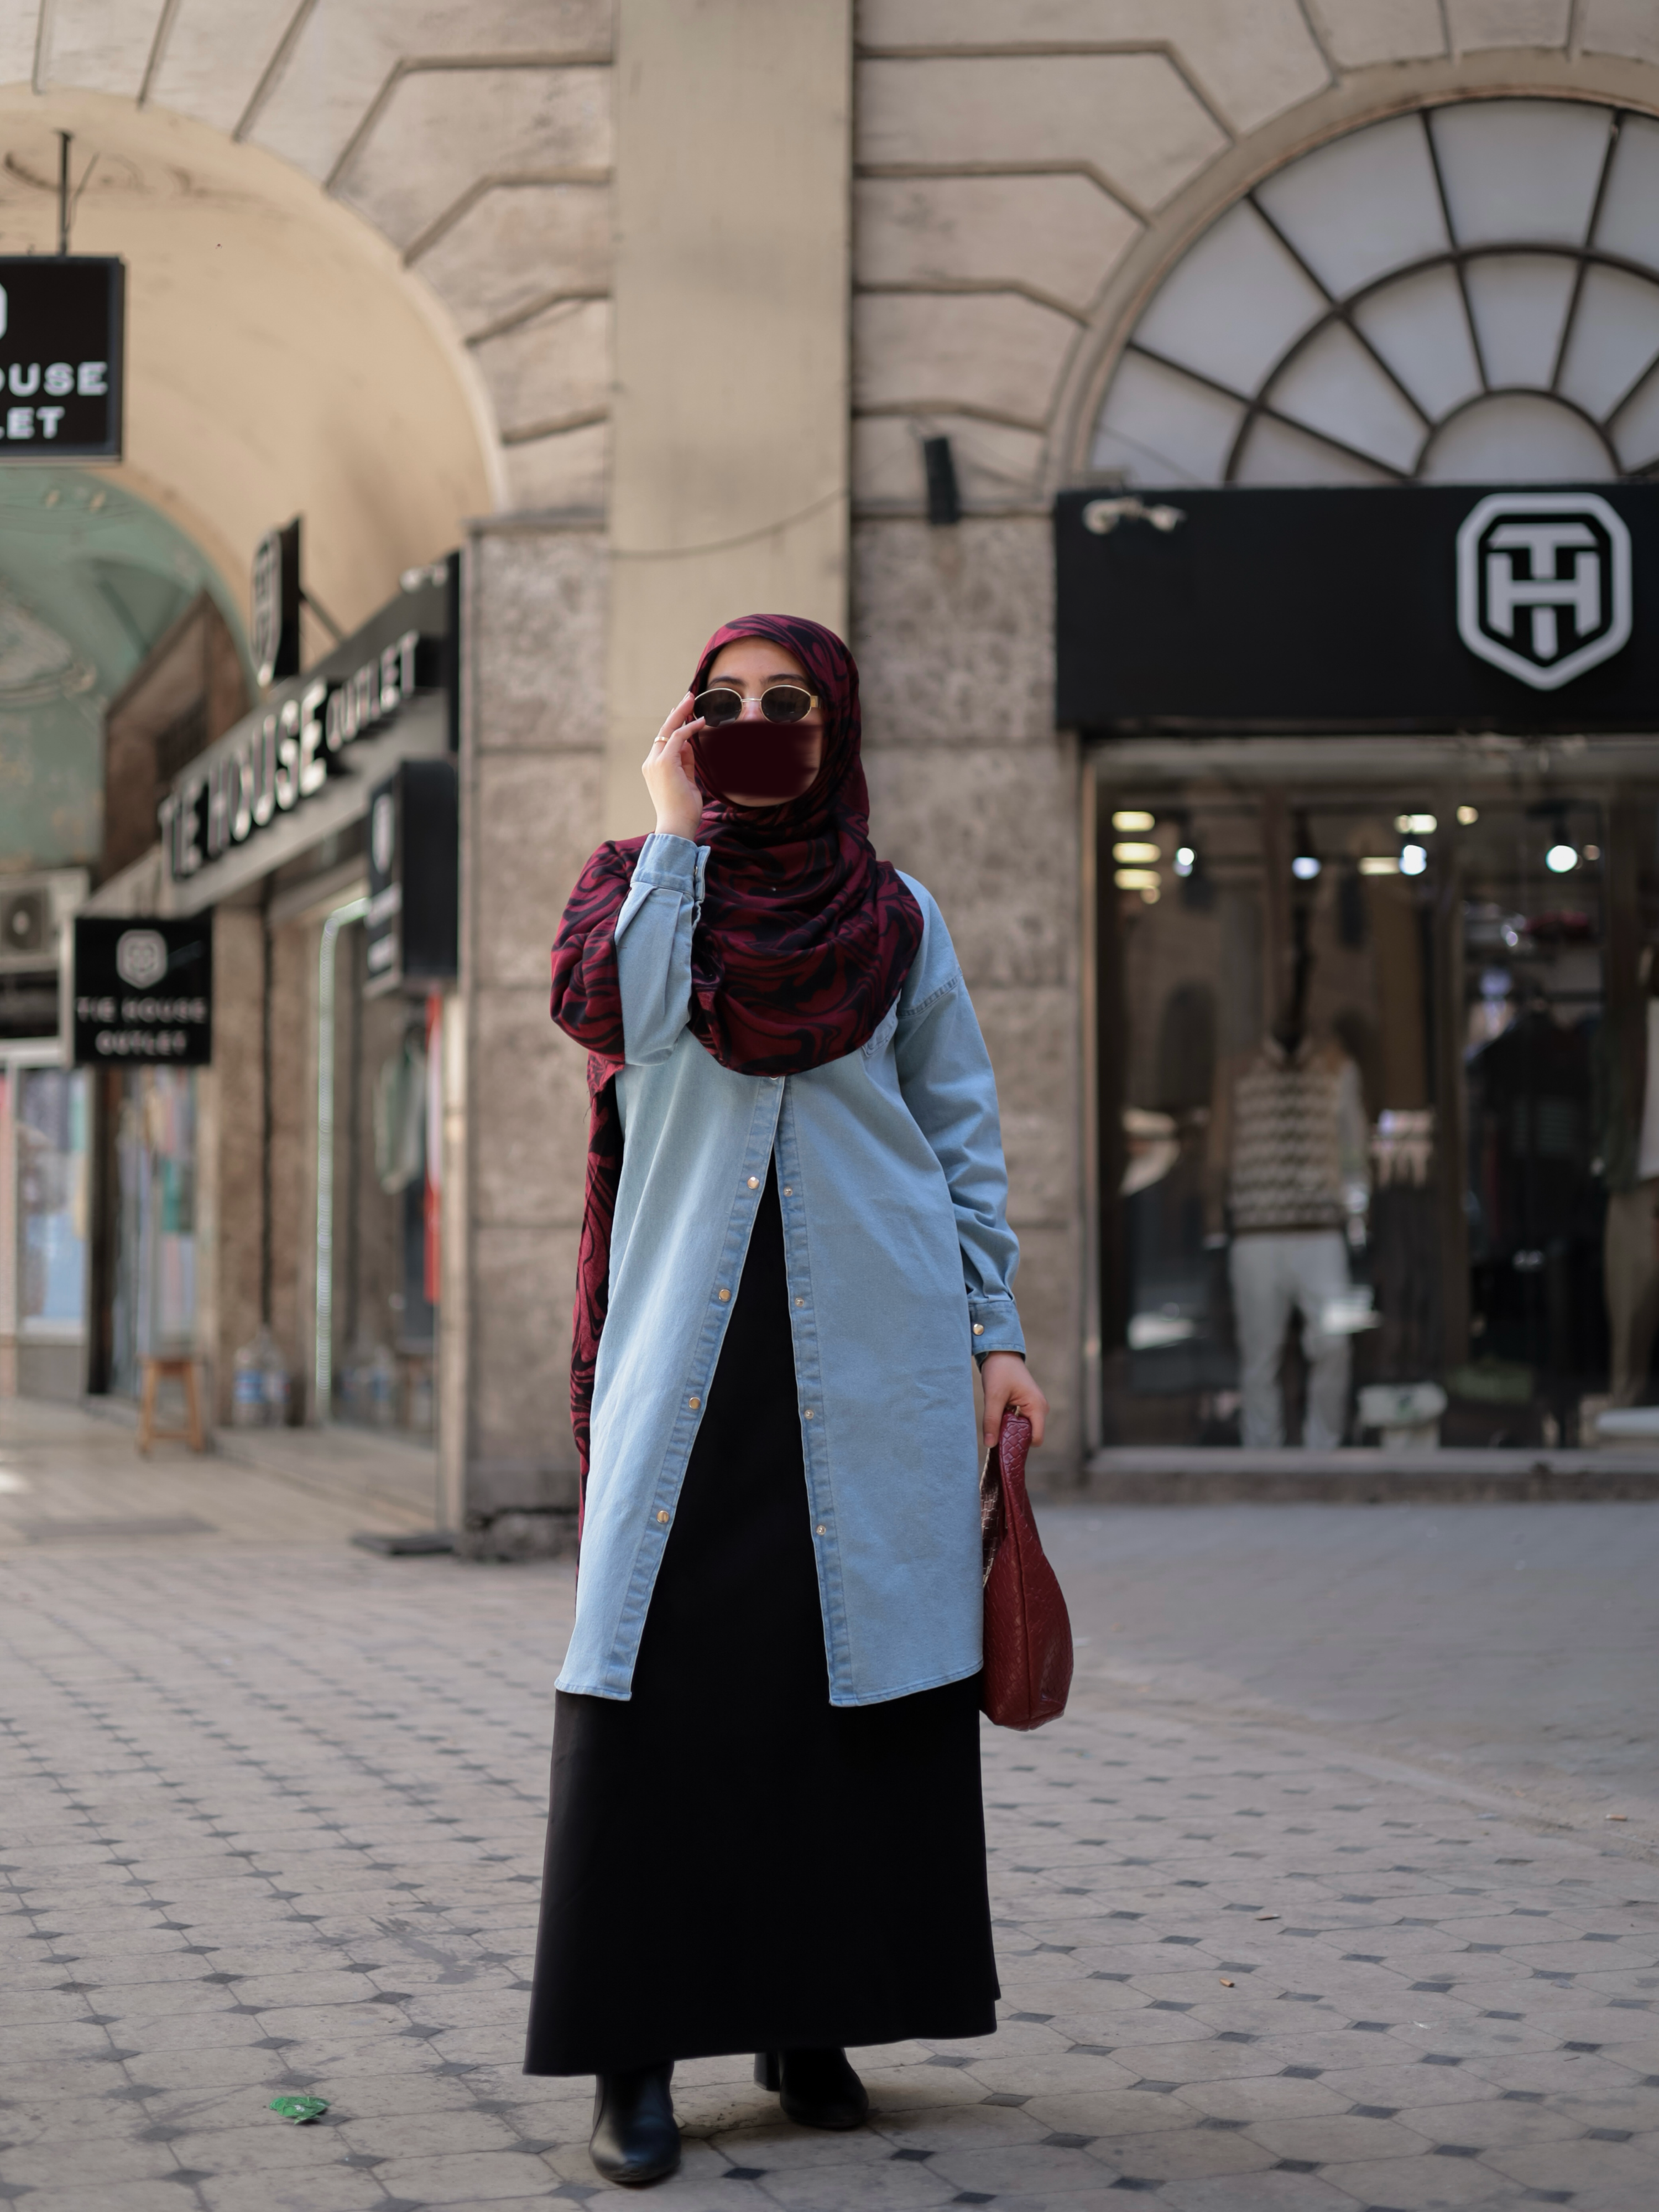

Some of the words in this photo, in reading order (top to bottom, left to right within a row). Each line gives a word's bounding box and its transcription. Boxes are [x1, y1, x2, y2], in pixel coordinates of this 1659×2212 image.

[0, 362, 108, 397] USE
[0, 406, 65, 439] ET
[207, 677, 327, 858] HOUSE
